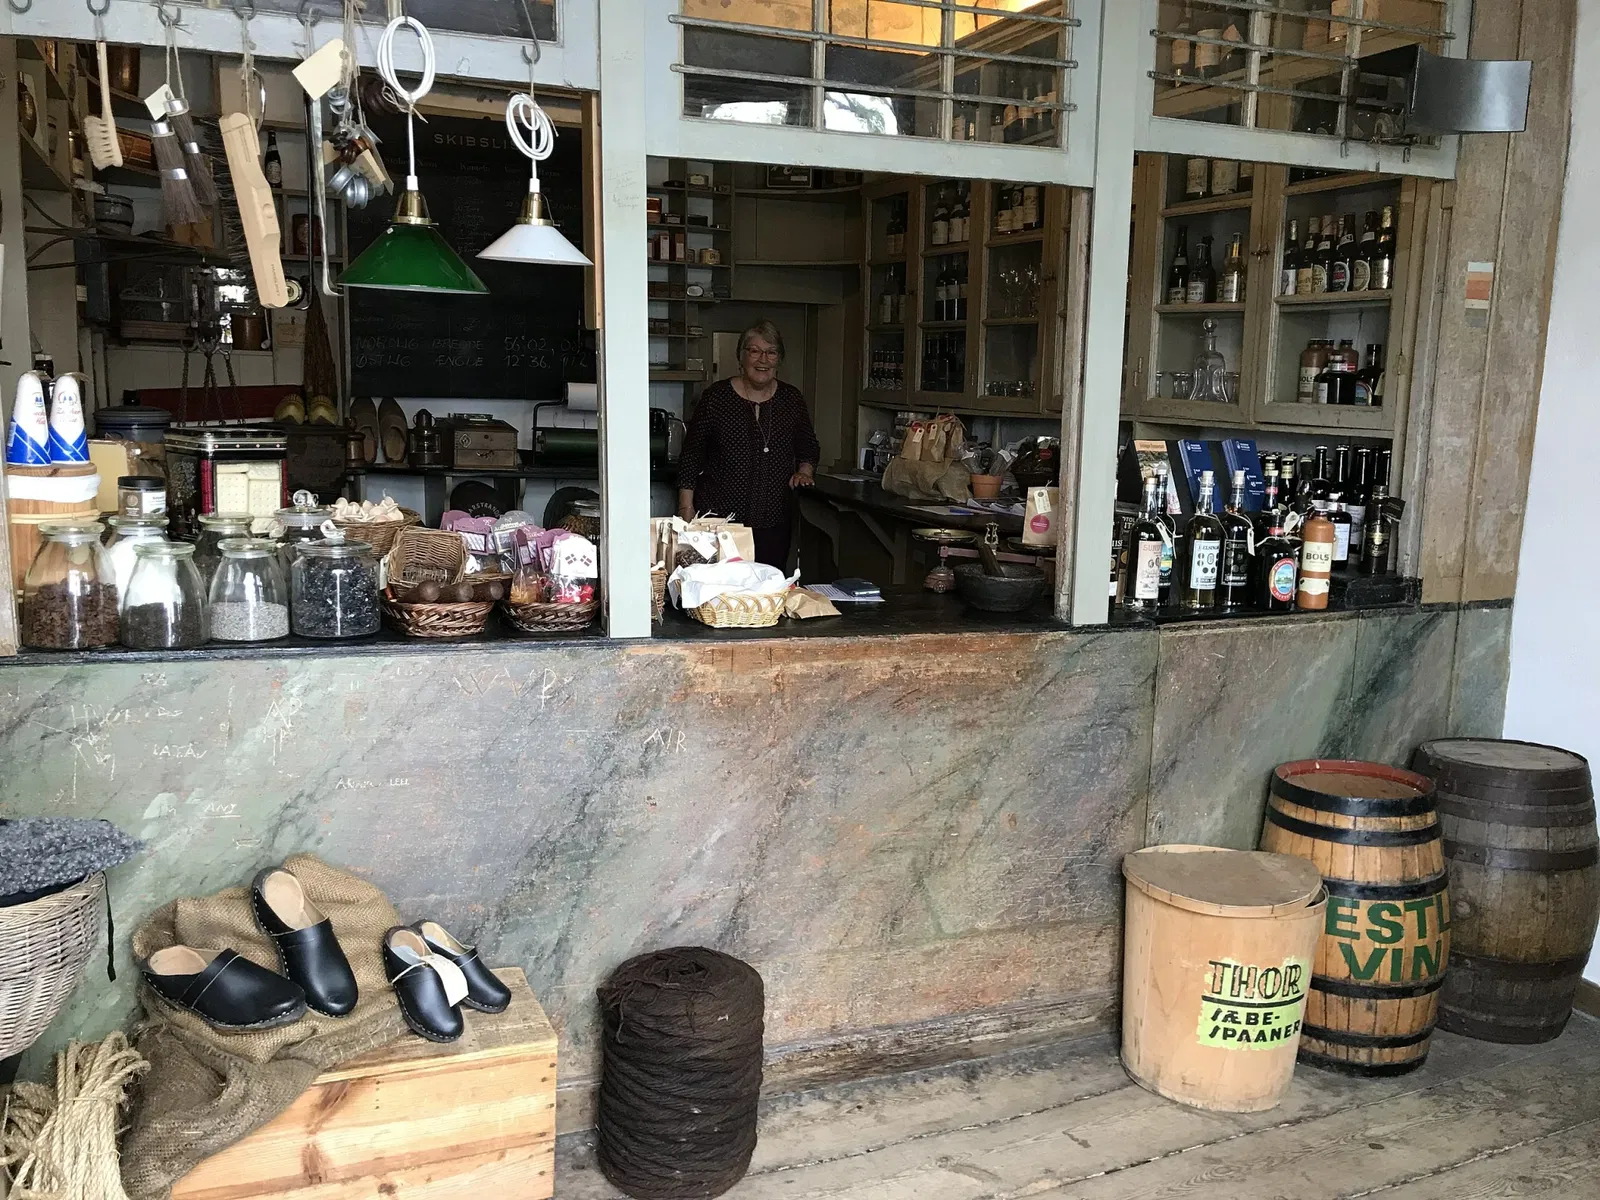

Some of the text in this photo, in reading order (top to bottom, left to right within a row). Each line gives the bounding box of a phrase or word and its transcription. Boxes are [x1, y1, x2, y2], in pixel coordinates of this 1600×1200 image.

[1305, 552, 1330, 562] BOLS
[1208, 960, 1302, 999] THOR
[1338, 939, 1442, 982] VIN
